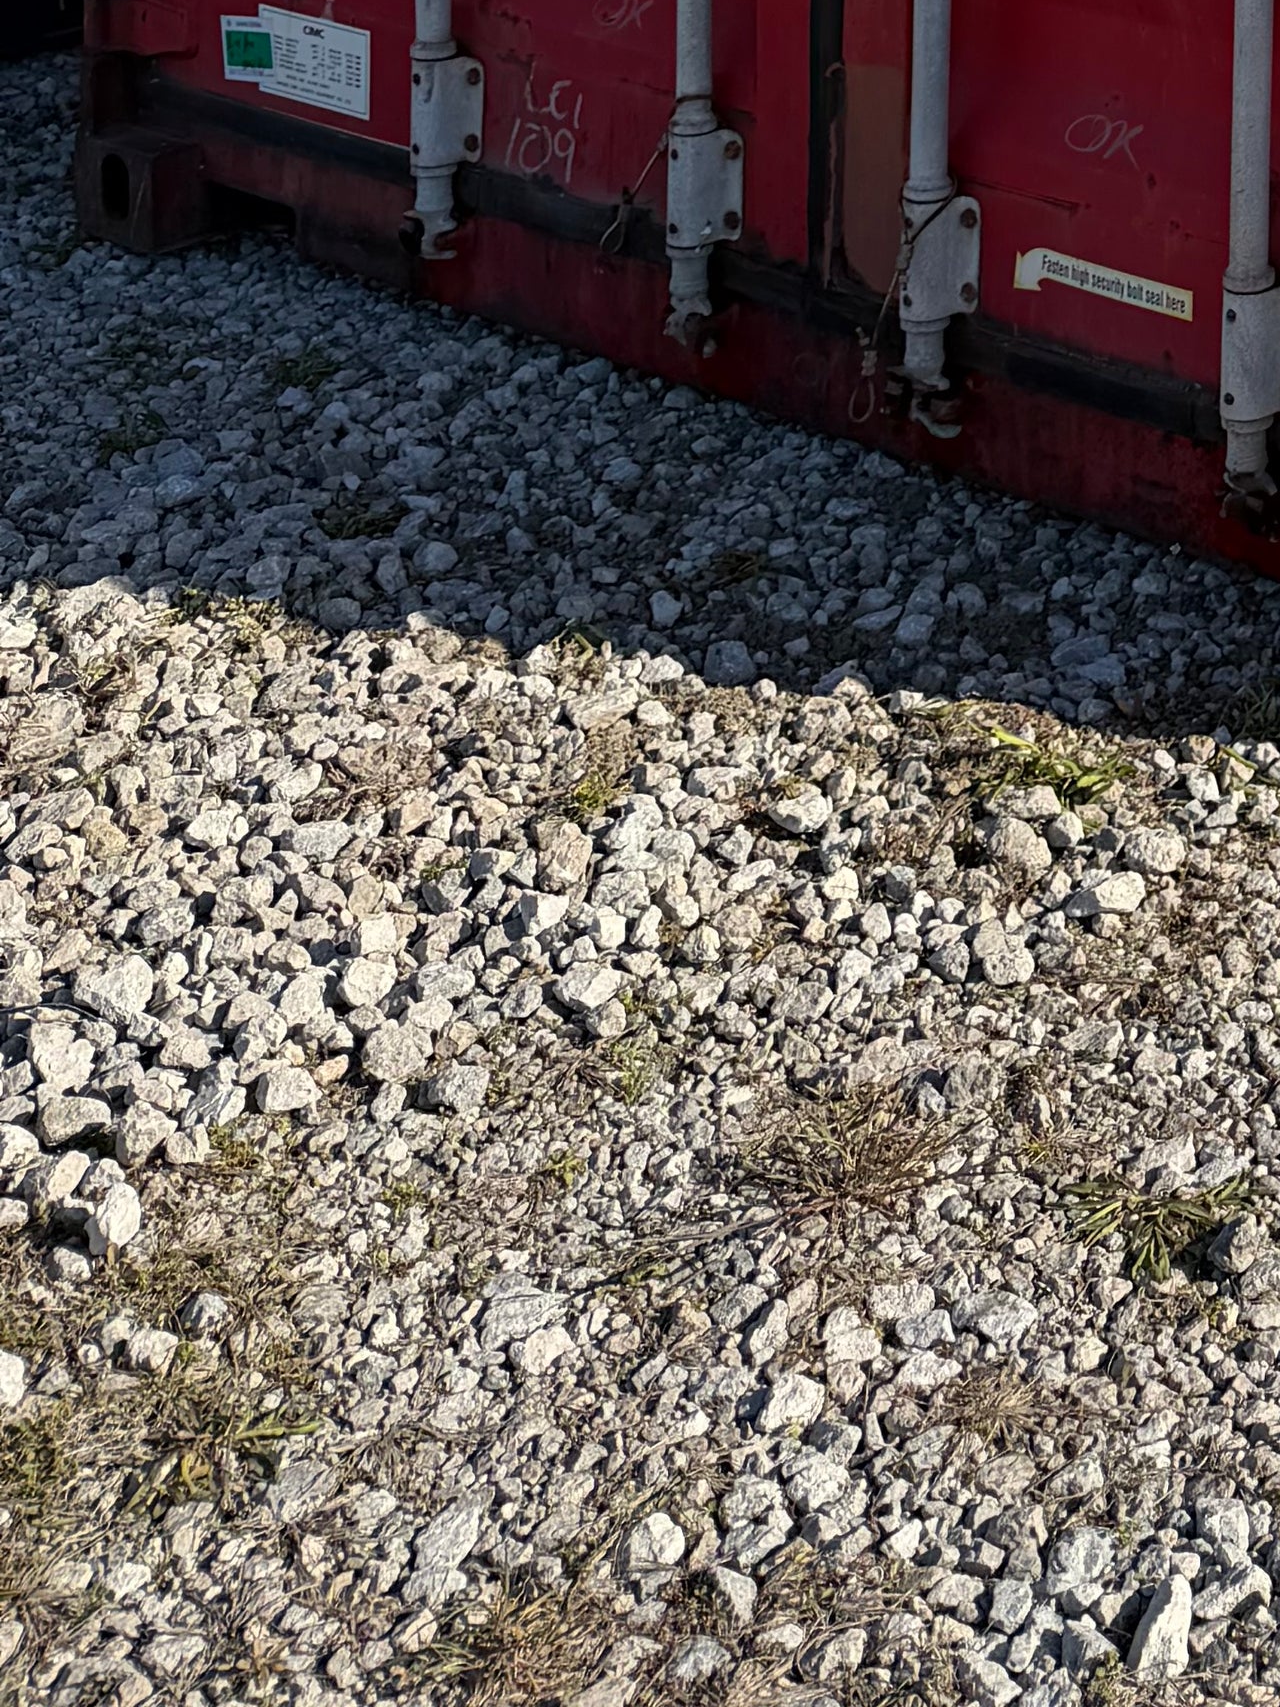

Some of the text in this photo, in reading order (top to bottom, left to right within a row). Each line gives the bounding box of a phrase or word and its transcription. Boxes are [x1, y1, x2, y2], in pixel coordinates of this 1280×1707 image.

[1041, 254, 1070, 279] Fasten
[1071, 264, 1091, 287] high
[1091, 272, 1125, 299] security
[1145, 290, 1164, 307] seal
[1165, 292, 1186, 314] here
